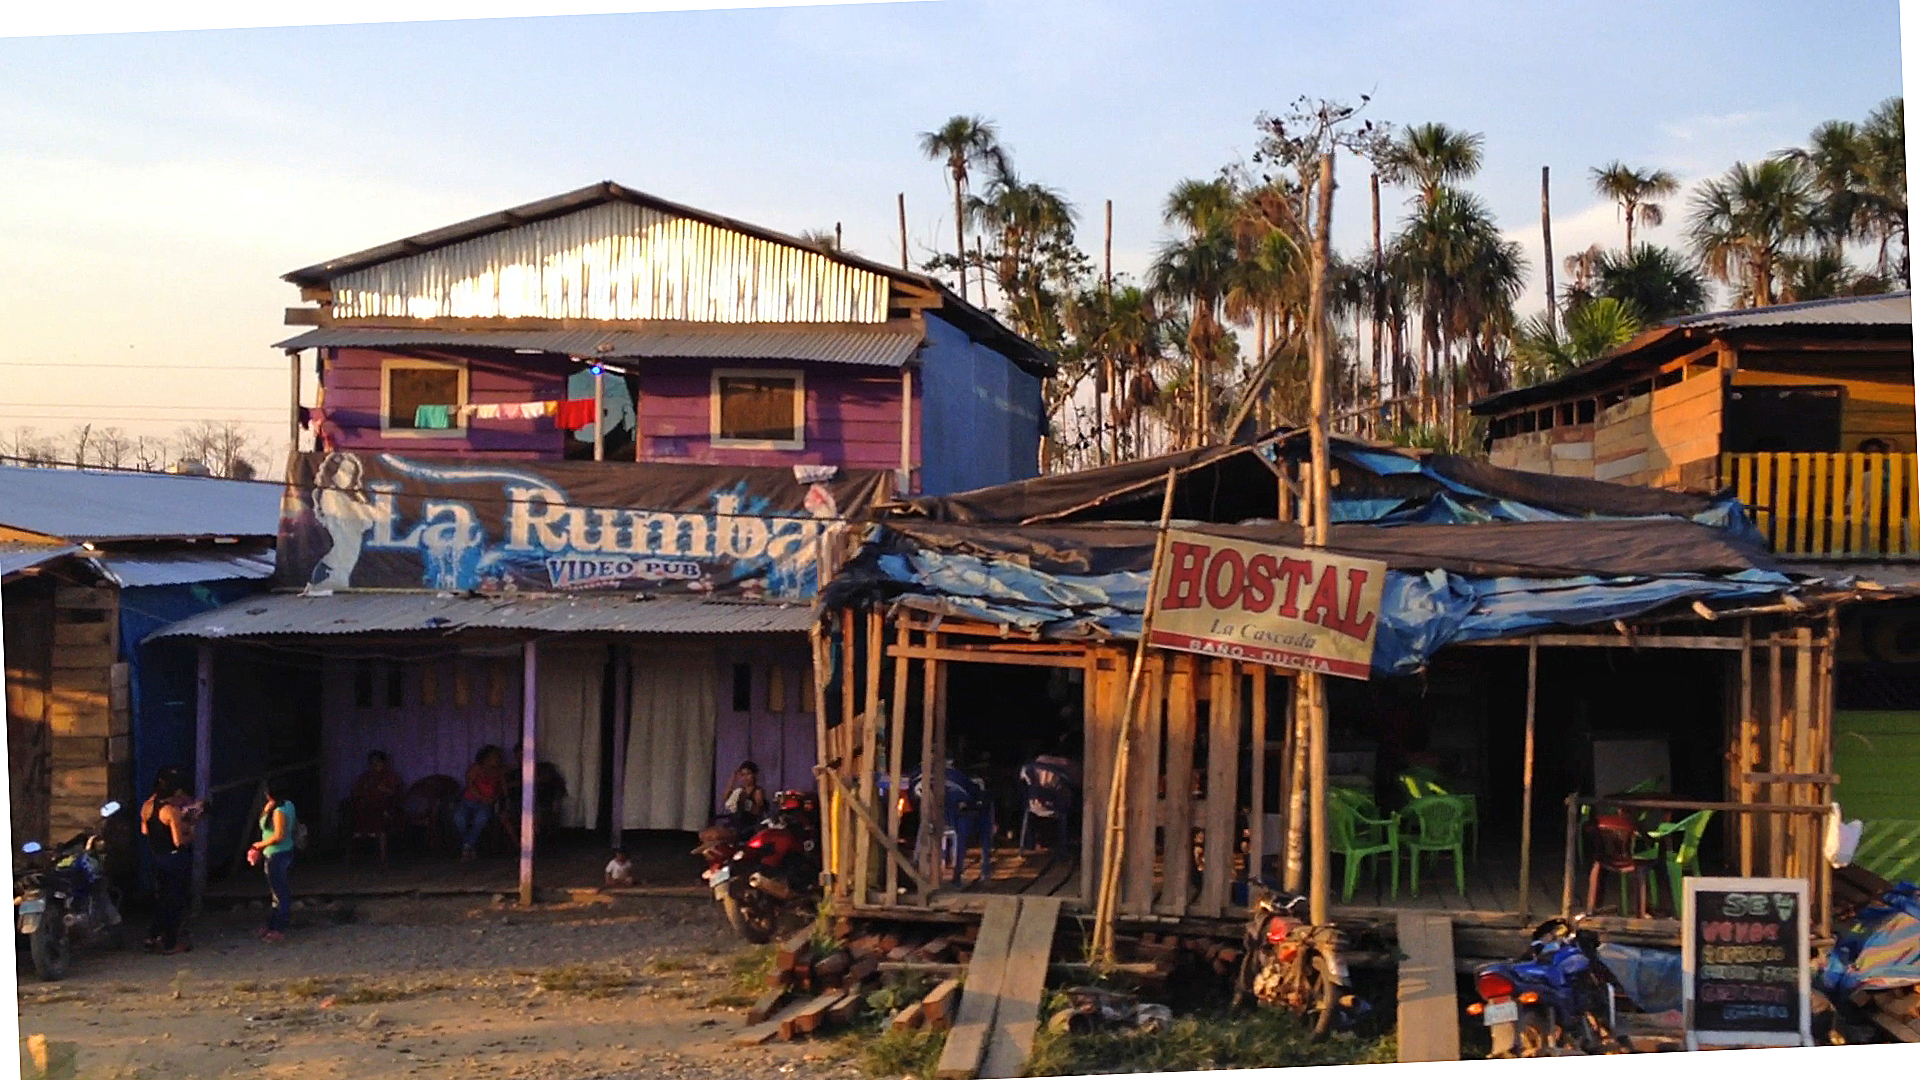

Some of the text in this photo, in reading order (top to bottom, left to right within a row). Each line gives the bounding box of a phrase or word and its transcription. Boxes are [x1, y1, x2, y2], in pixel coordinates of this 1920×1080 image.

[366, 484, 817, 560] La Rumba
[549, 559, 698, 584] VIDEO PUB
[1161, 541, 1376, 643] HOSTAL
[1210, 617, 1317, 650] La Cascada
[1262, 652, 1331, 672] DUCHA
